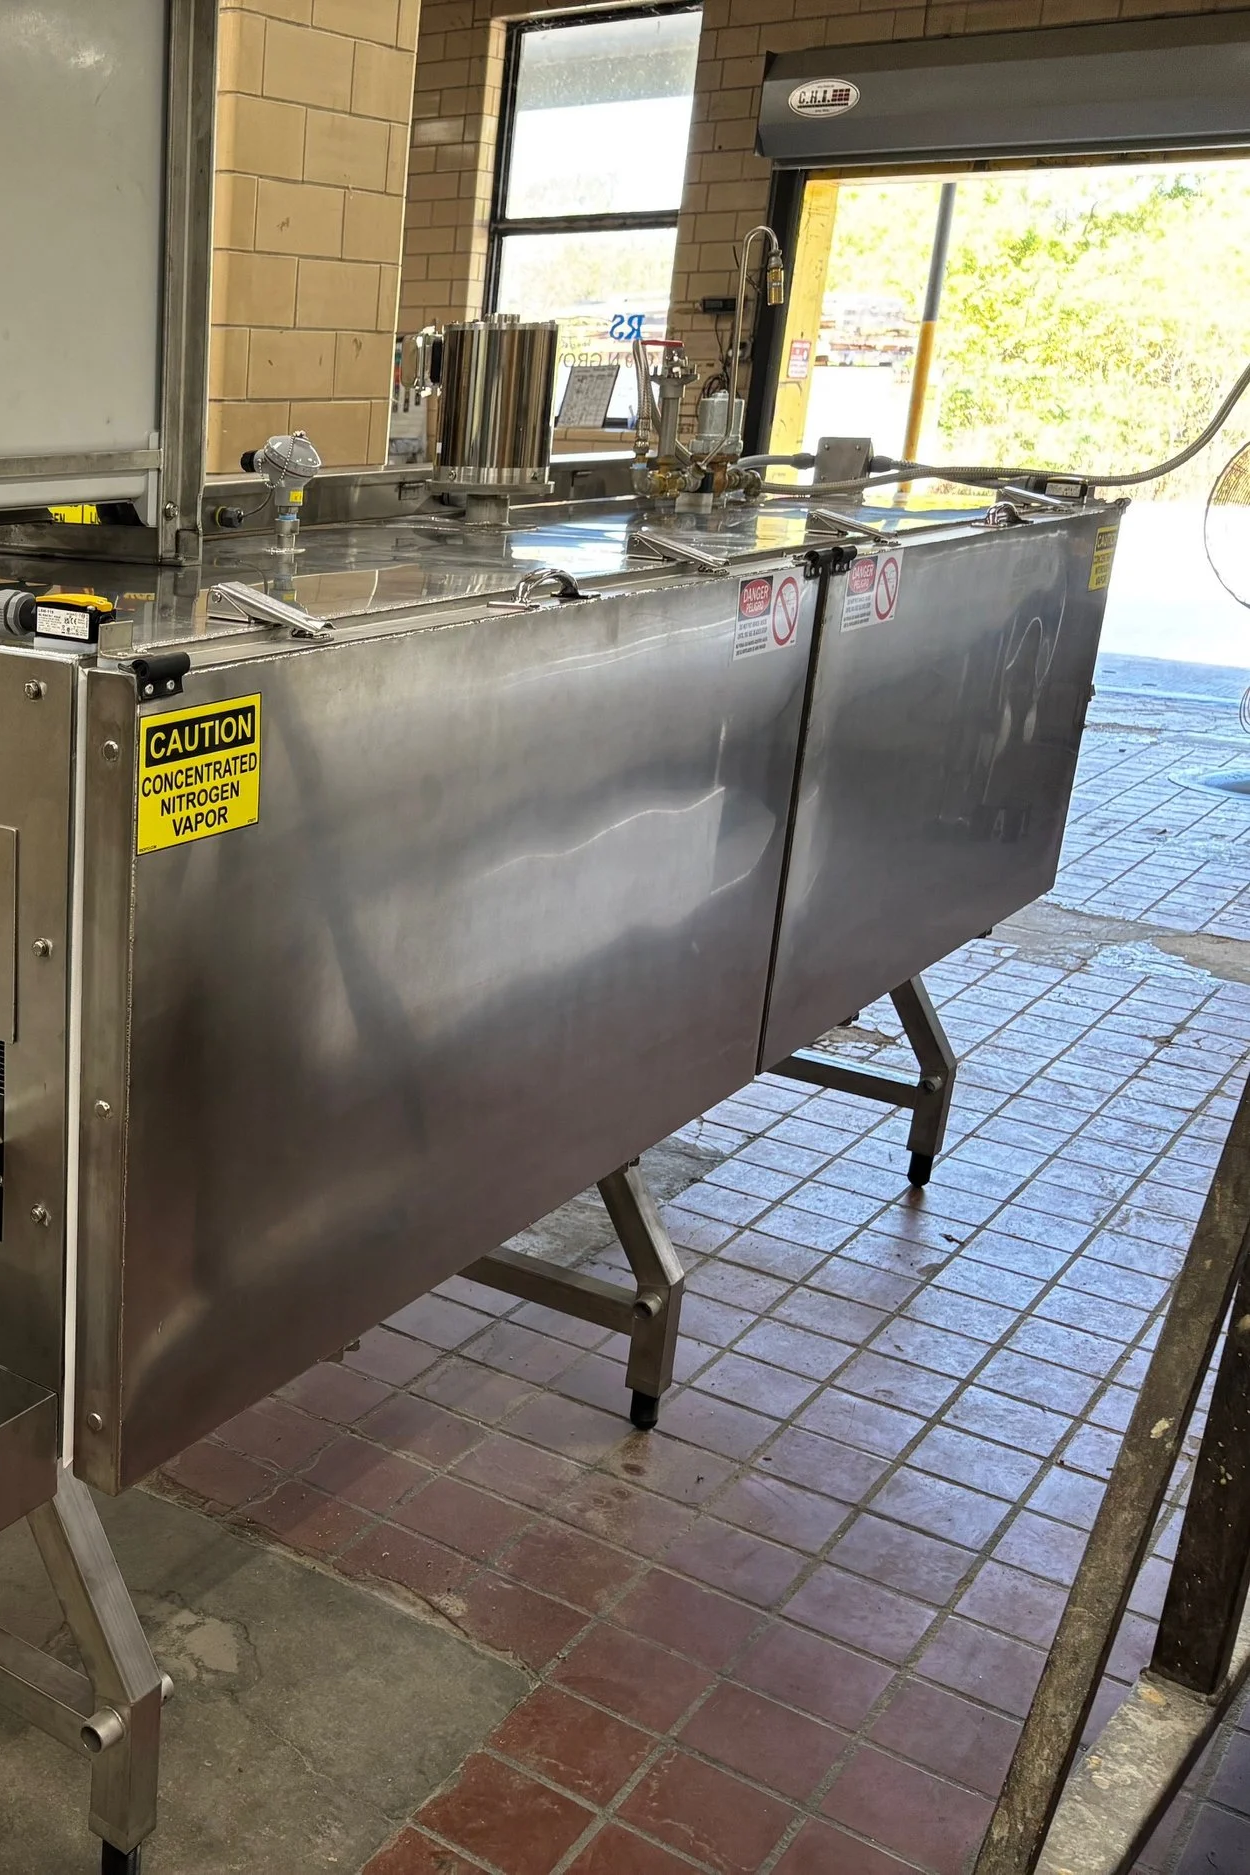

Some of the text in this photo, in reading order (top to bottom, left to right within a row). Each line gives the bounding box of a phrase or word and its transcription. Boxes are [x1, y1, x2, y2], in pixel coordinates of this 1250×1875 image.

[743, 585, 769, 604] DANGER
[745, 600, 765, 613] PELIGRO
[150, 712, 252, 759] CAUTION
[141, 752, 257, 797] CONCENTRATED
[160, 780, 240, 817] NITROGEN
[172, 805, 229, 837] VAPOR
